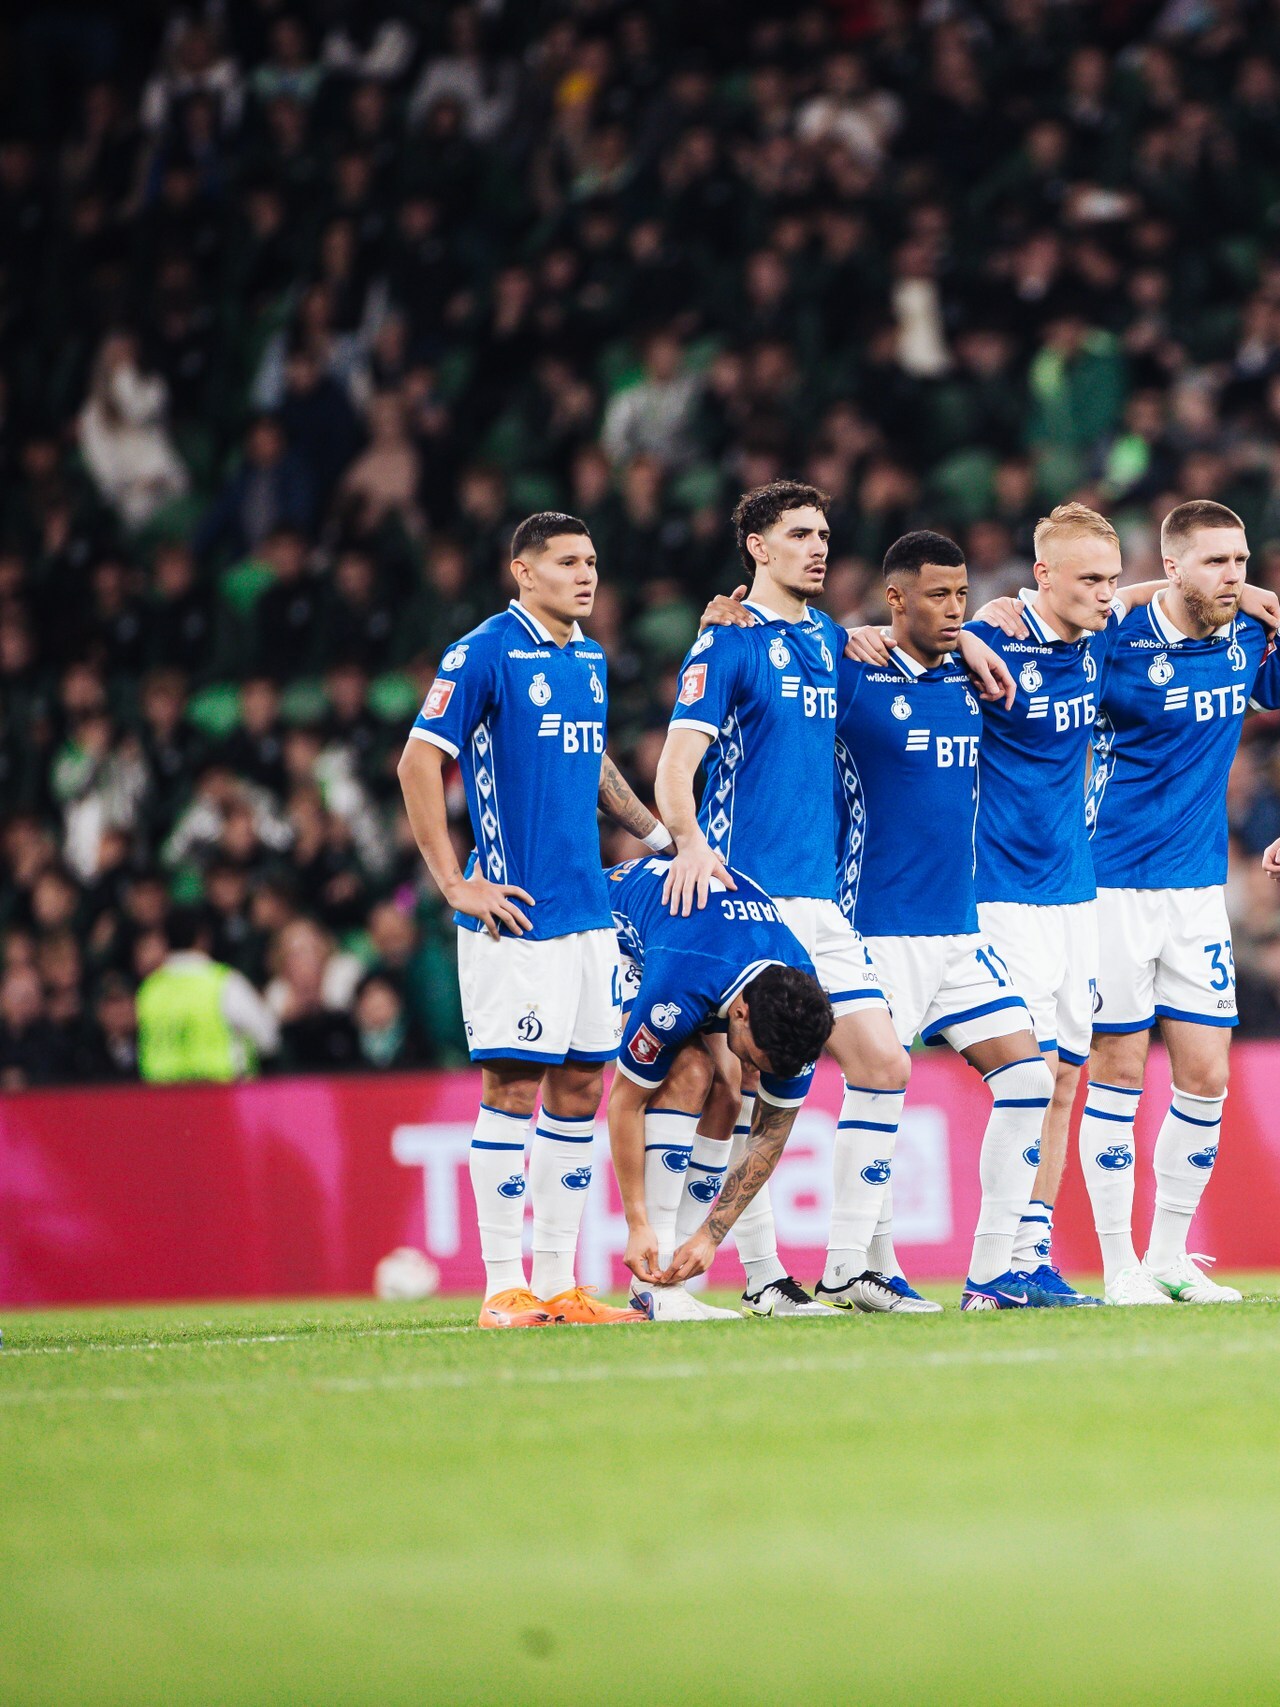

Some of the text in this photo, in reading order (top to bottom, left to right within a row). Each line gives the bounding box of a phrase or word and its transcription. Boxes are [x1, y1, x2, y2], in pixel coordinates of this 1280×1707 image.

[508, 649, 551, 660] wildberries
[574, 650, 604, 660] CHANGAN
[1002, 643, 1054, 655] wildberries
[943, 675, 970, 684] CHANGA
[803, 685, 837, 719] ВТБ
[1053, 692, 1097, 733] ВТБ
[1194, 683, 1247, 723] ВТБ
[562, 720, 604, 754] ВТБ
[936, 735, 980, 768] ВТБ
